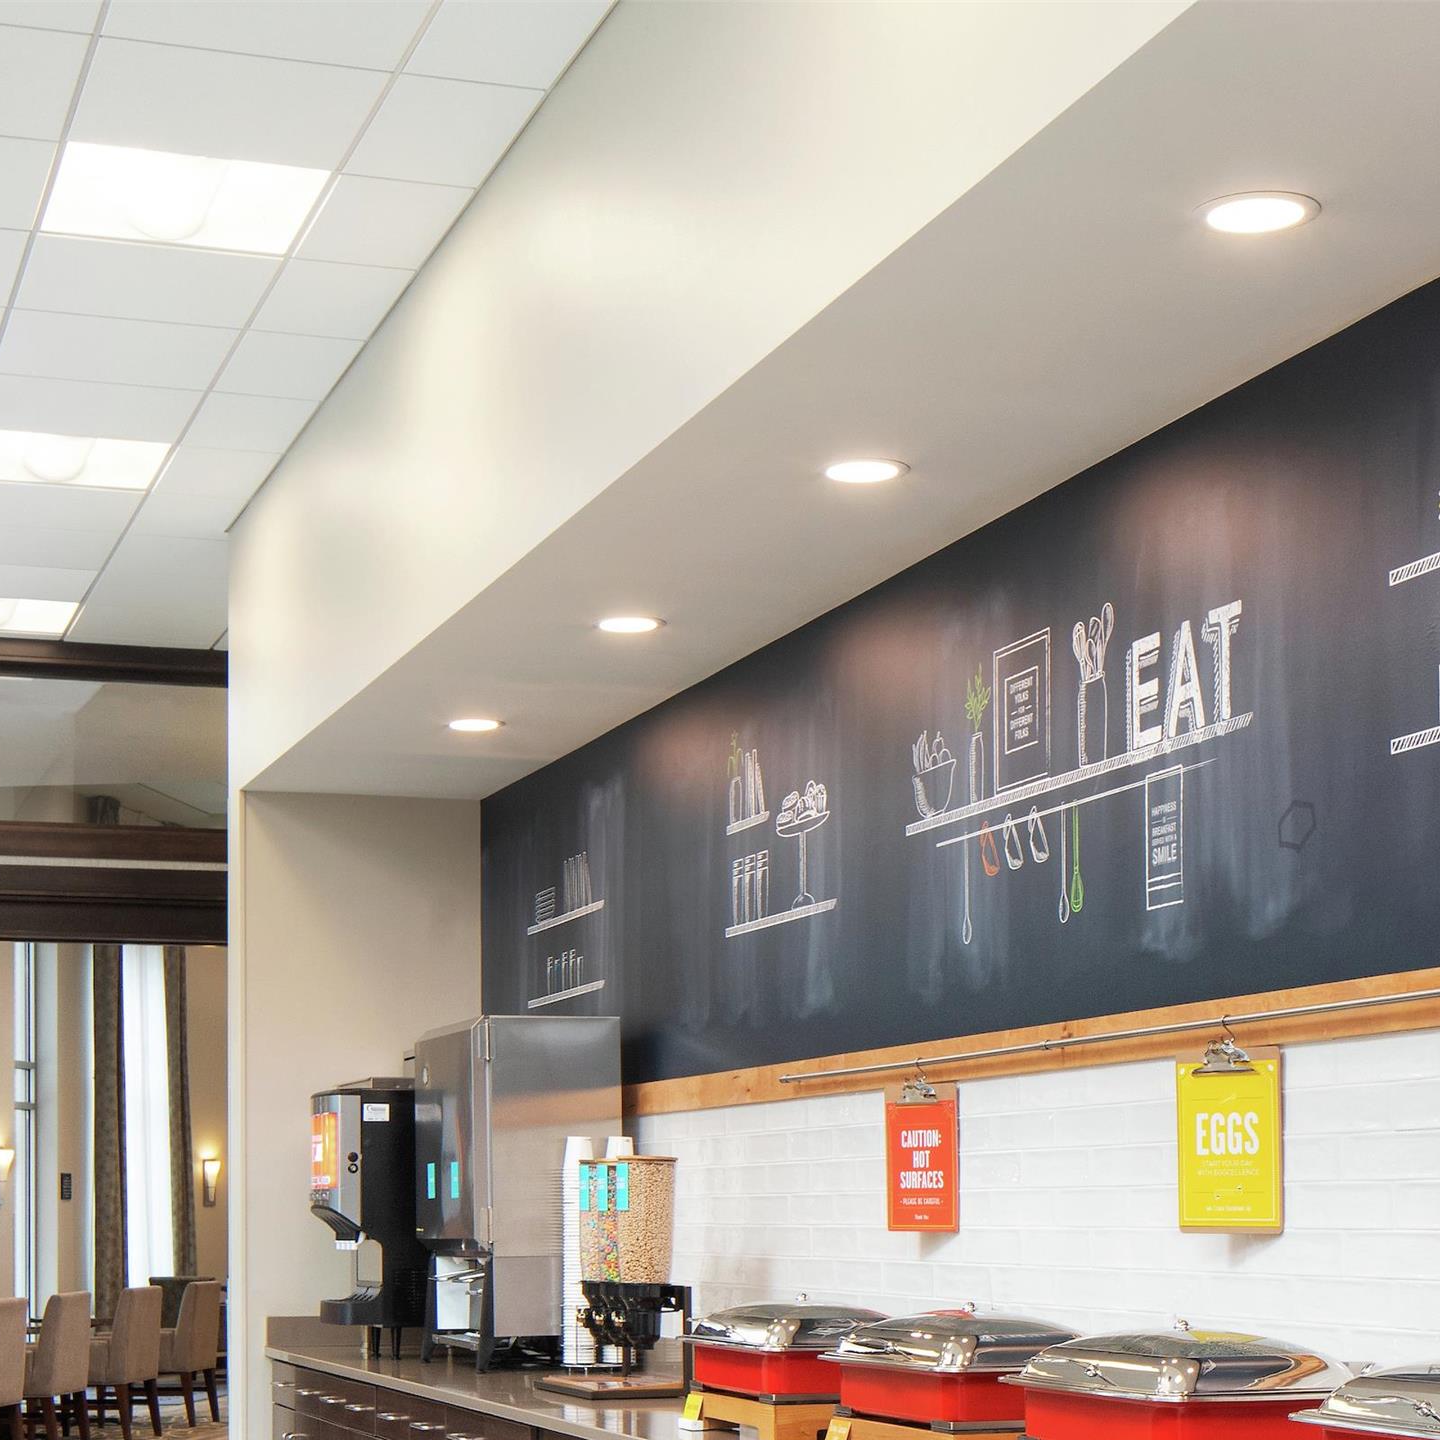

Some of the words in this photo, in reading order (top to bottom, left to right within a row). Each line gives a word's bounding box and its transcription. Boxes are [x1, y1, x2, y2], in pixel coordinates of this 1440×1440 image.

[1127, 599, 1242, 750] EAT
[1152, 801, 1177, 817] HAPPINESS
[1152, 822, 1177, 837] BREAKFAST
[1152, 843, 1177, 866] SMILE
[901, 1129, 942, 1148] CAUTION:
[1196, 1112, 1259, 1156] EGGS
[912, 1150, 930, 1168] HOT
[900, 1171, 944, 1189] SURFACES
